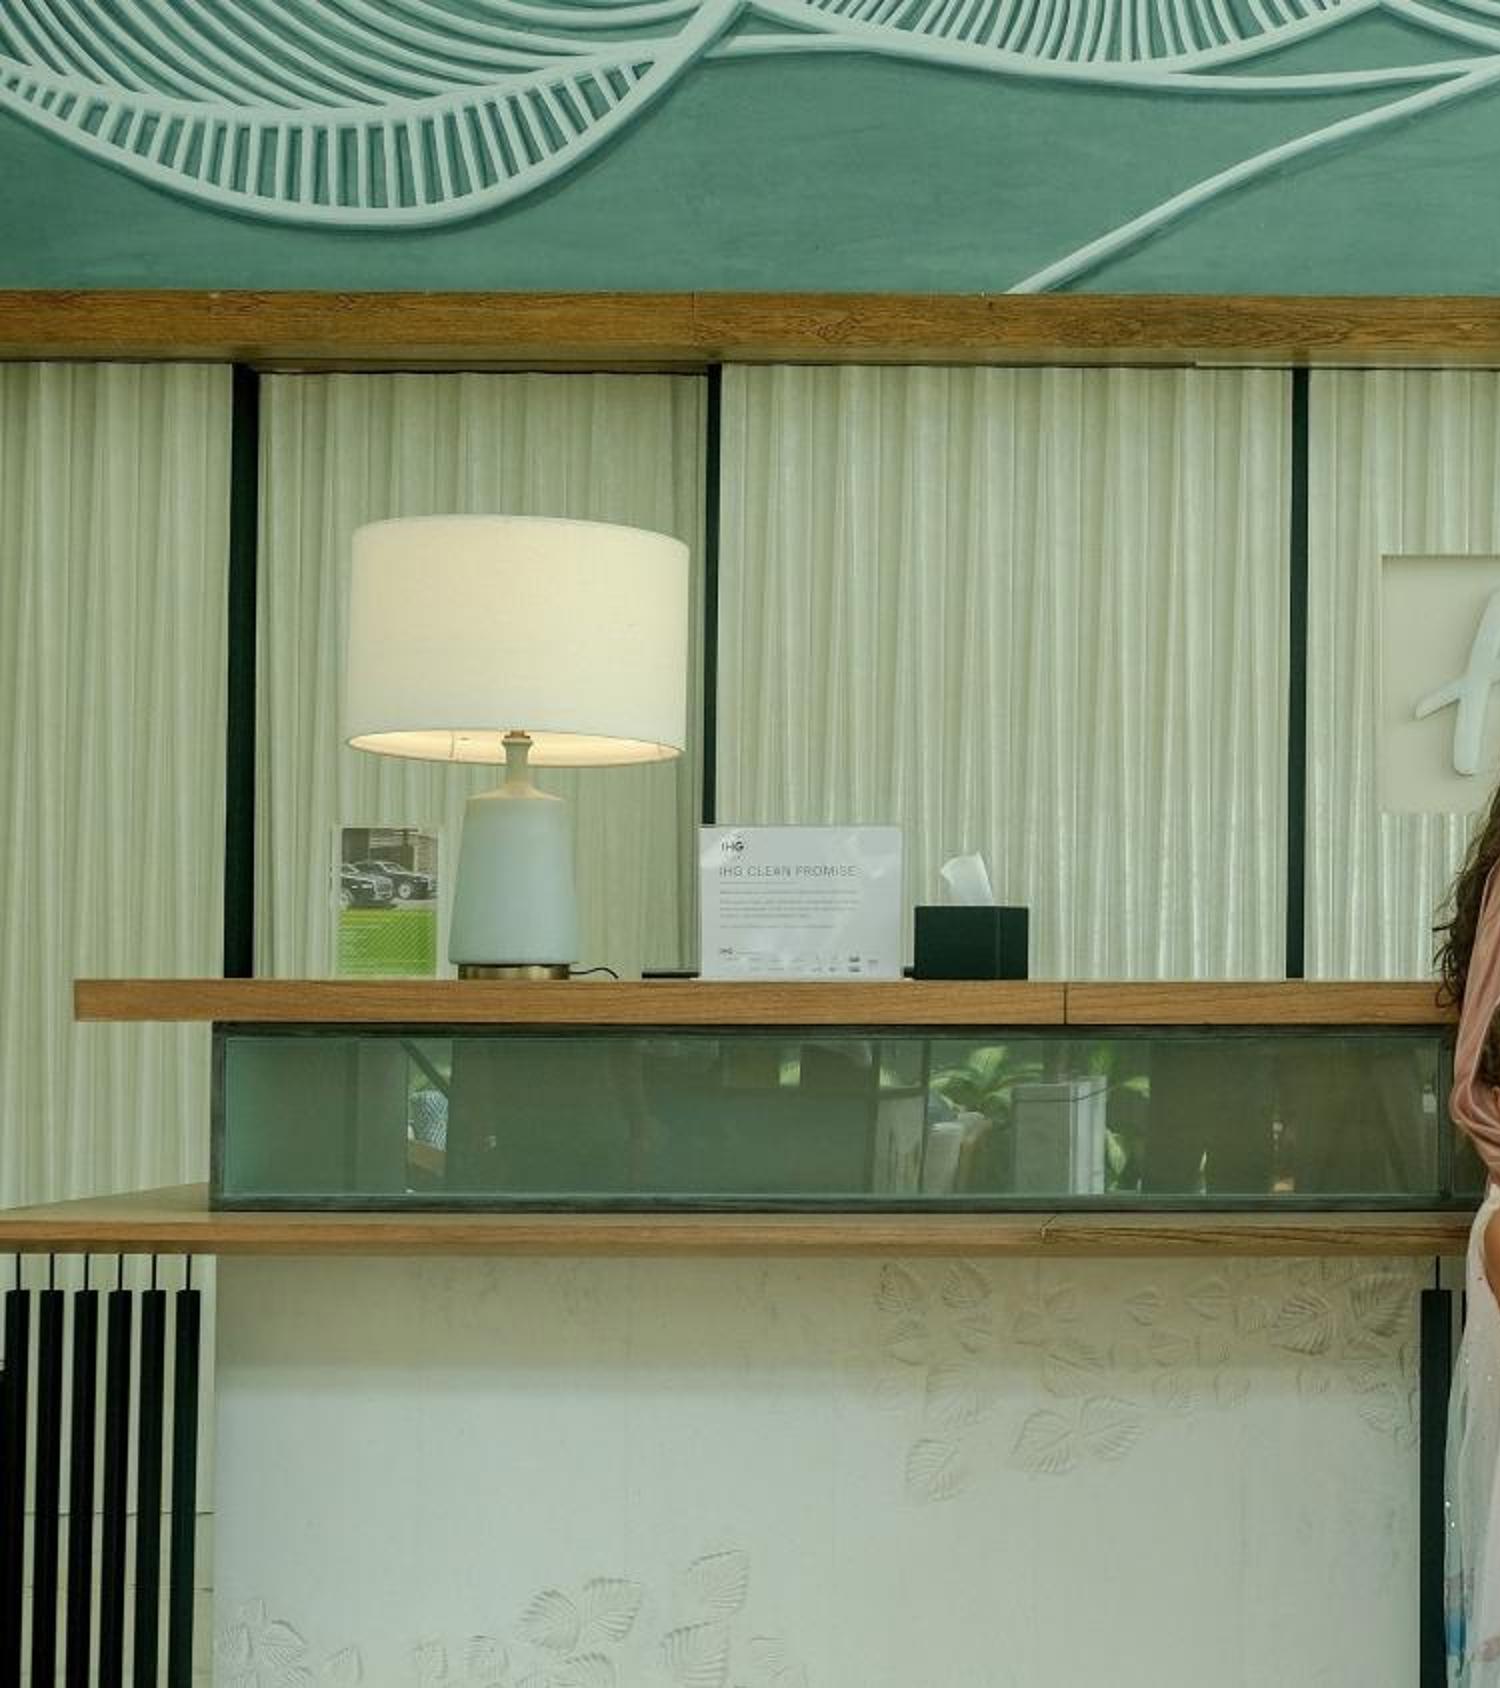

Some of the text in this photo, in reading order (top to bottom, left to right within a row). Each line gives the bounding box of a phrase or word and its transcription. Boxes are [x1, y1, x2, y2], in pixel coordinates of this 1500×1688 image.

[721, 841, 744, 852] IHG
[719, 865, 857, 877] IHG CLEAN PROMISE
